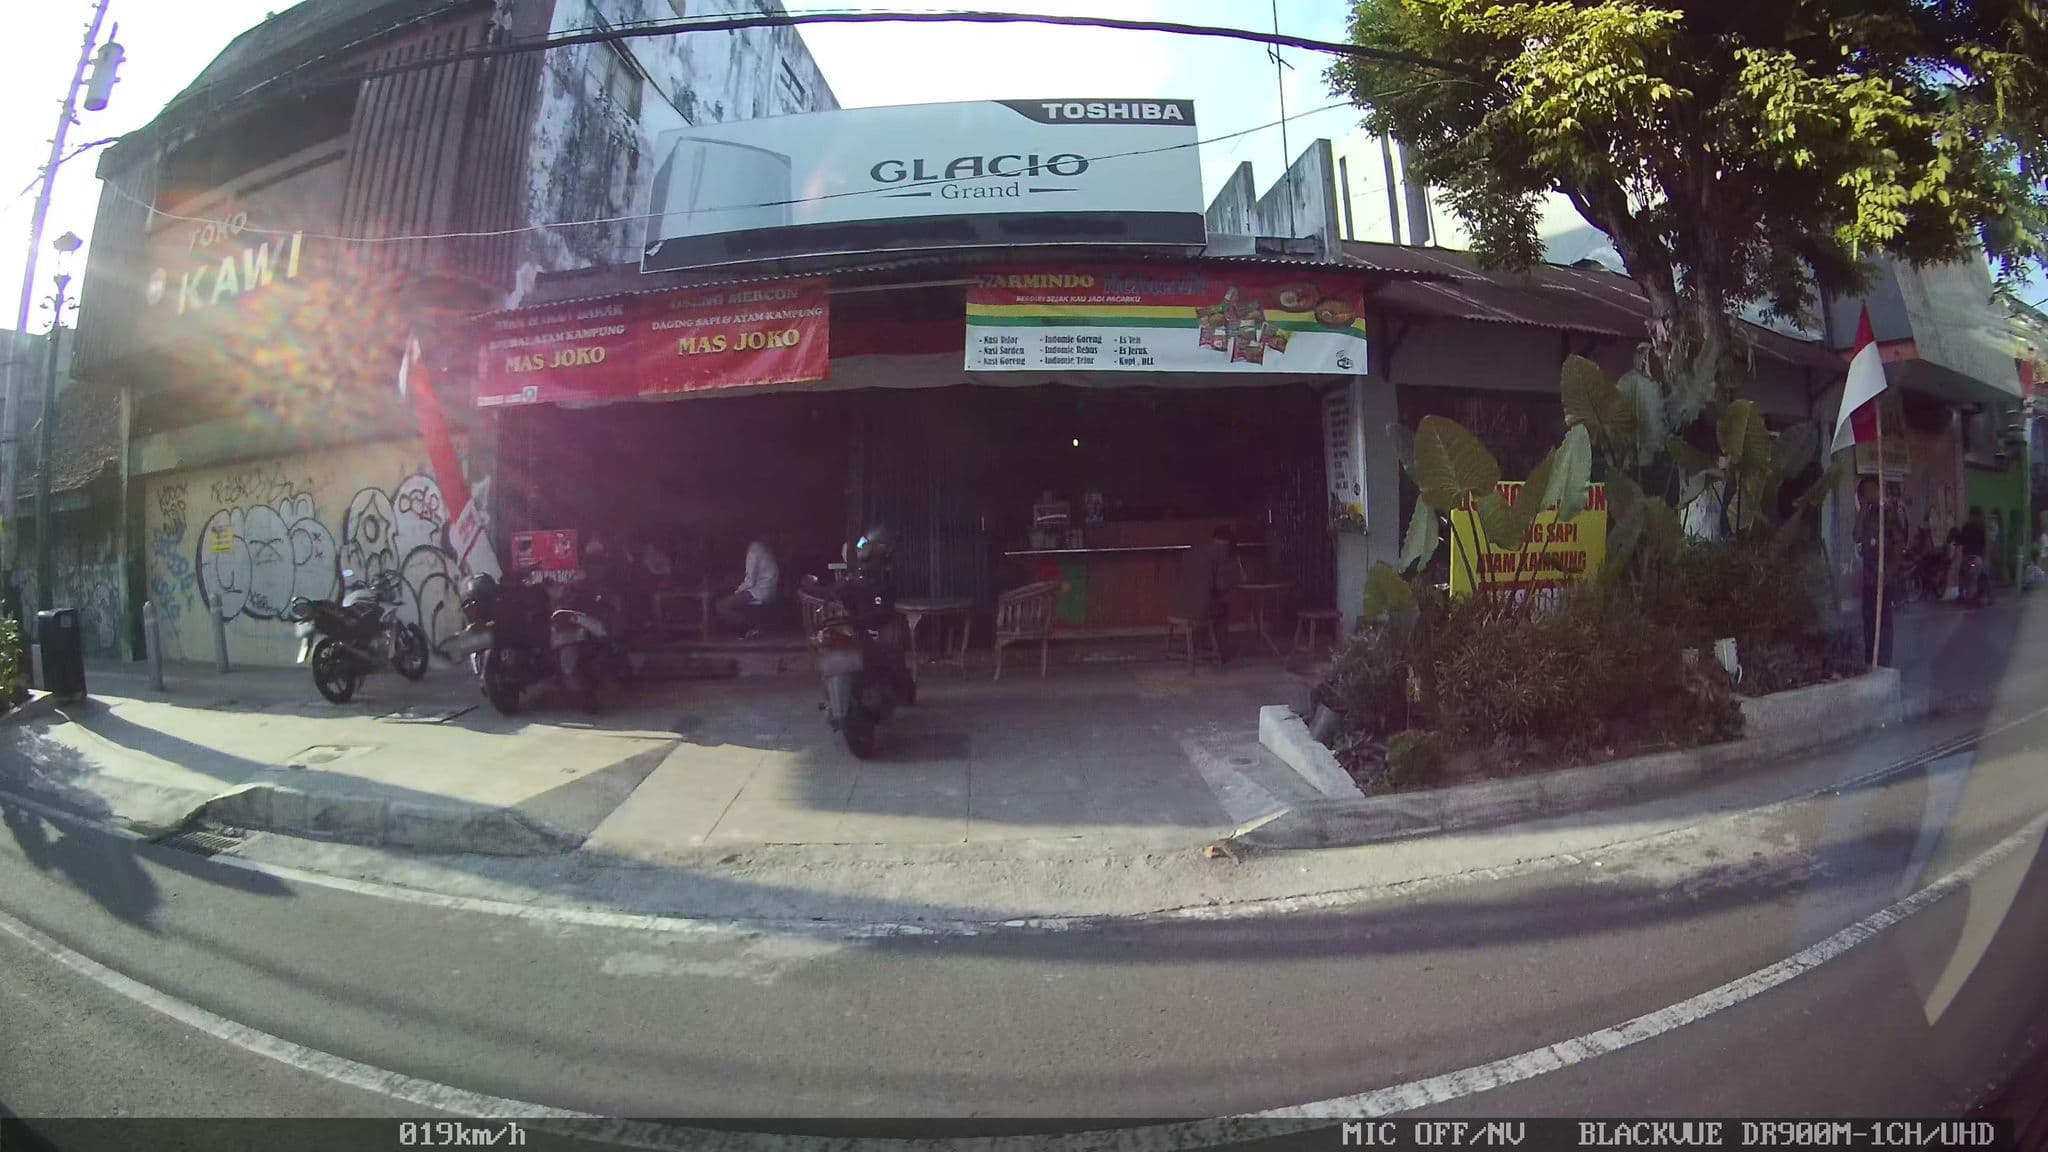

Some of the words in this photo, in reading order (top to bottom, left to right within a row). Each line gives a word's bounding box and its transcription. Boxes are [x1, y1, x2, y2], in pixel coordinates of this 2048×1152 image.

[1042, 102, 1185, 121] TOSHIBA
[870, 153, 1089, 183] GLACIO
[940, 181, 1021, 201] Grand
[176, 230, 304, 316] KAWI
[651, 319, 694, 332] DAGING
[732, 313, 764, 325] AYAM
[764, 307, 825, 321] KAMPUNG
[677, 334, 728, 355] MAS
[732, 329, 802, 351] JOKO
[505, 353, 545, 374] MAS
[549, 346, 608, 368] JOKO
[1547, 523, 1578, 543] SAPI
